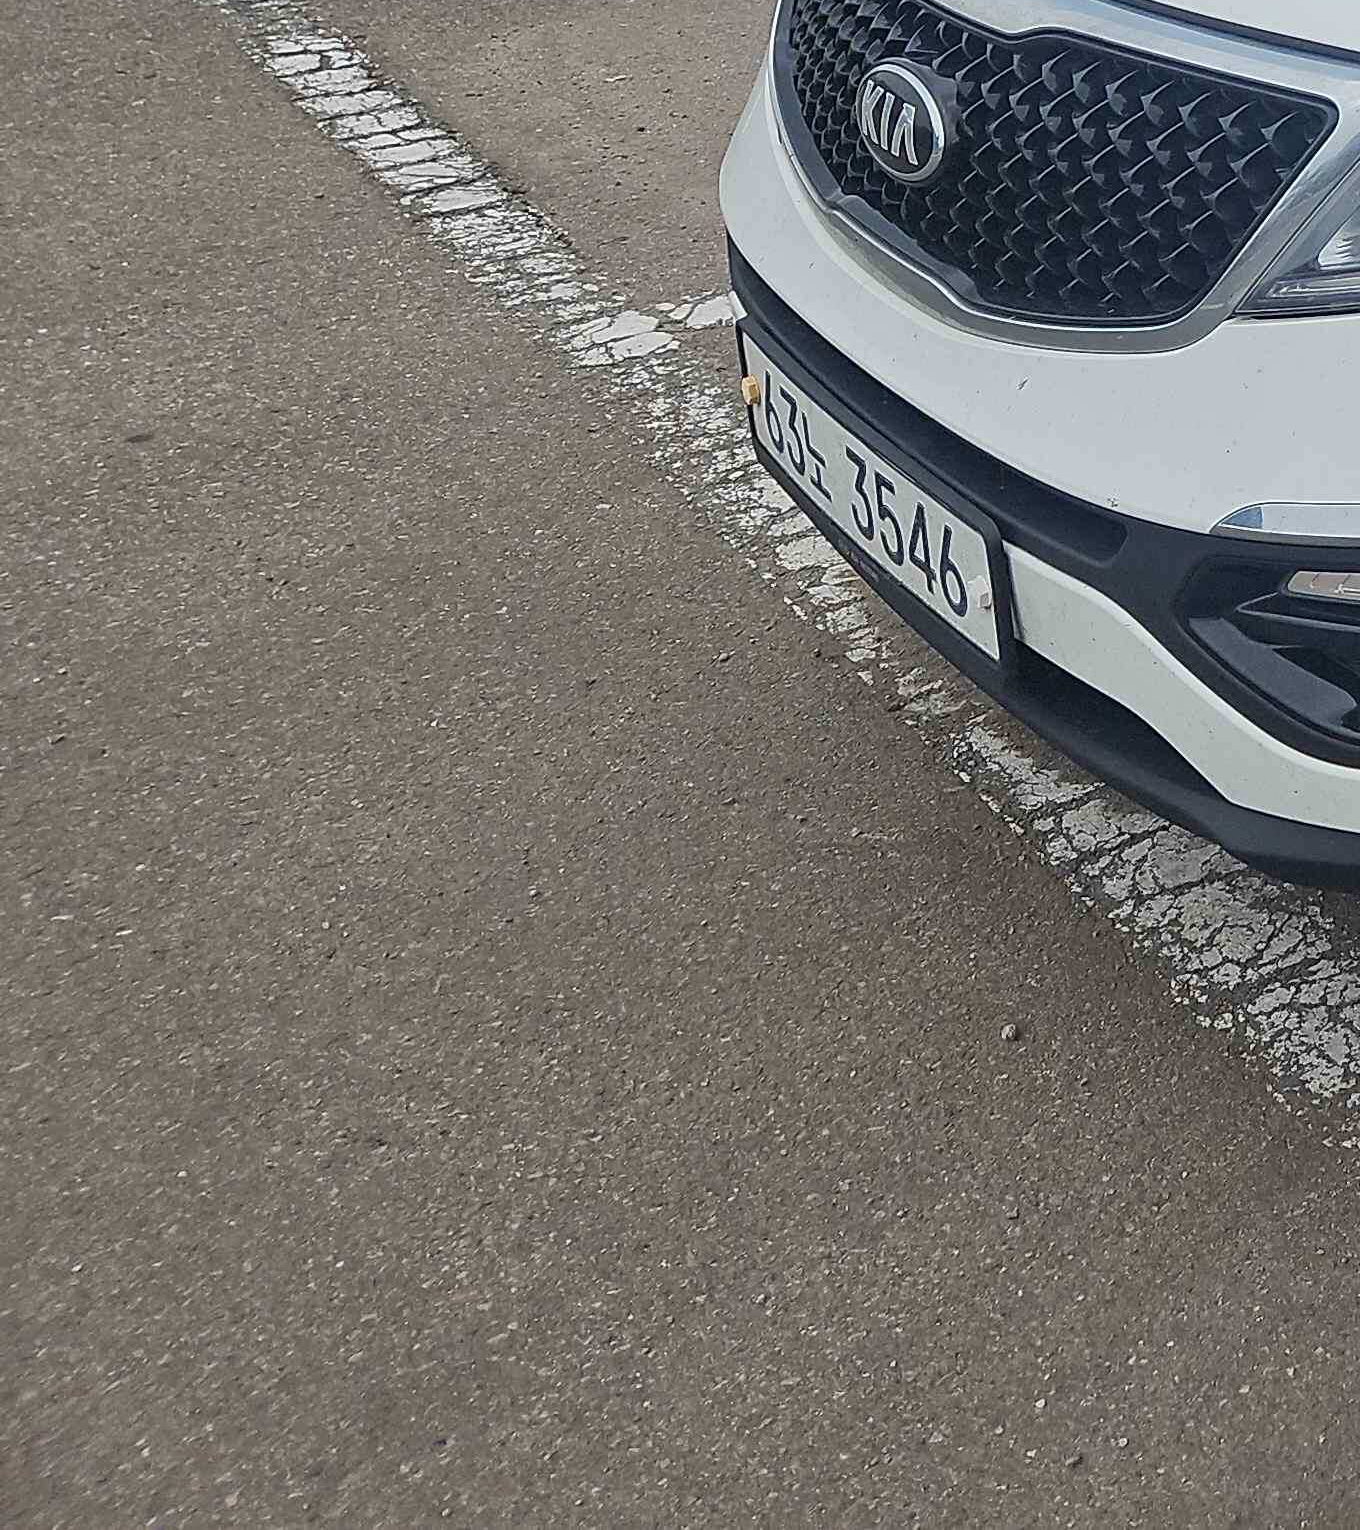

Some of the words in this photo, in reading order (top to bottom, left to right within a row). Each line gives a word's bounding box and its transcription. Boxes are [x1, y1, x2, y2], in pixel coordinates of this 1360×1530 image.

[861, 80, 918, 165] KIA
[765, 370, 832, 502] 63노
[846, 445, 968, 617] 3546
